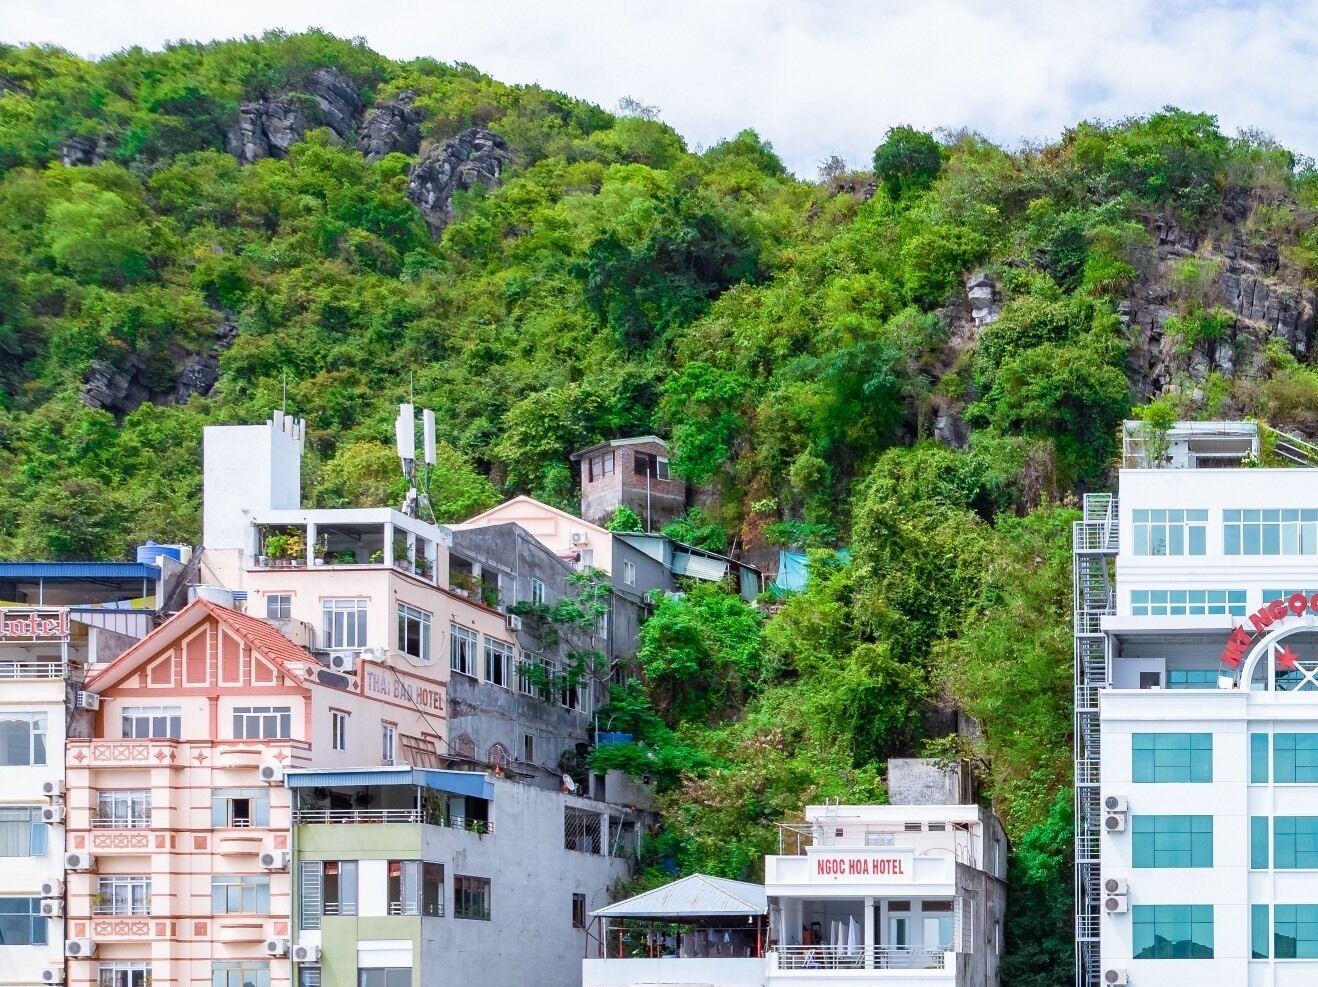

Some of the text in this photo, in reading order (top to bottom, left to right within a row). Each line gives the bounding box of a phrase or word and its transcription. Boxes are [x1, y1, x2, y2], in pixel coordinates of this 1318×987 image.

[416, 685, 444, 711] HOTEL
[817, 859, 904, 880] NGỌC HOA HOTEL
